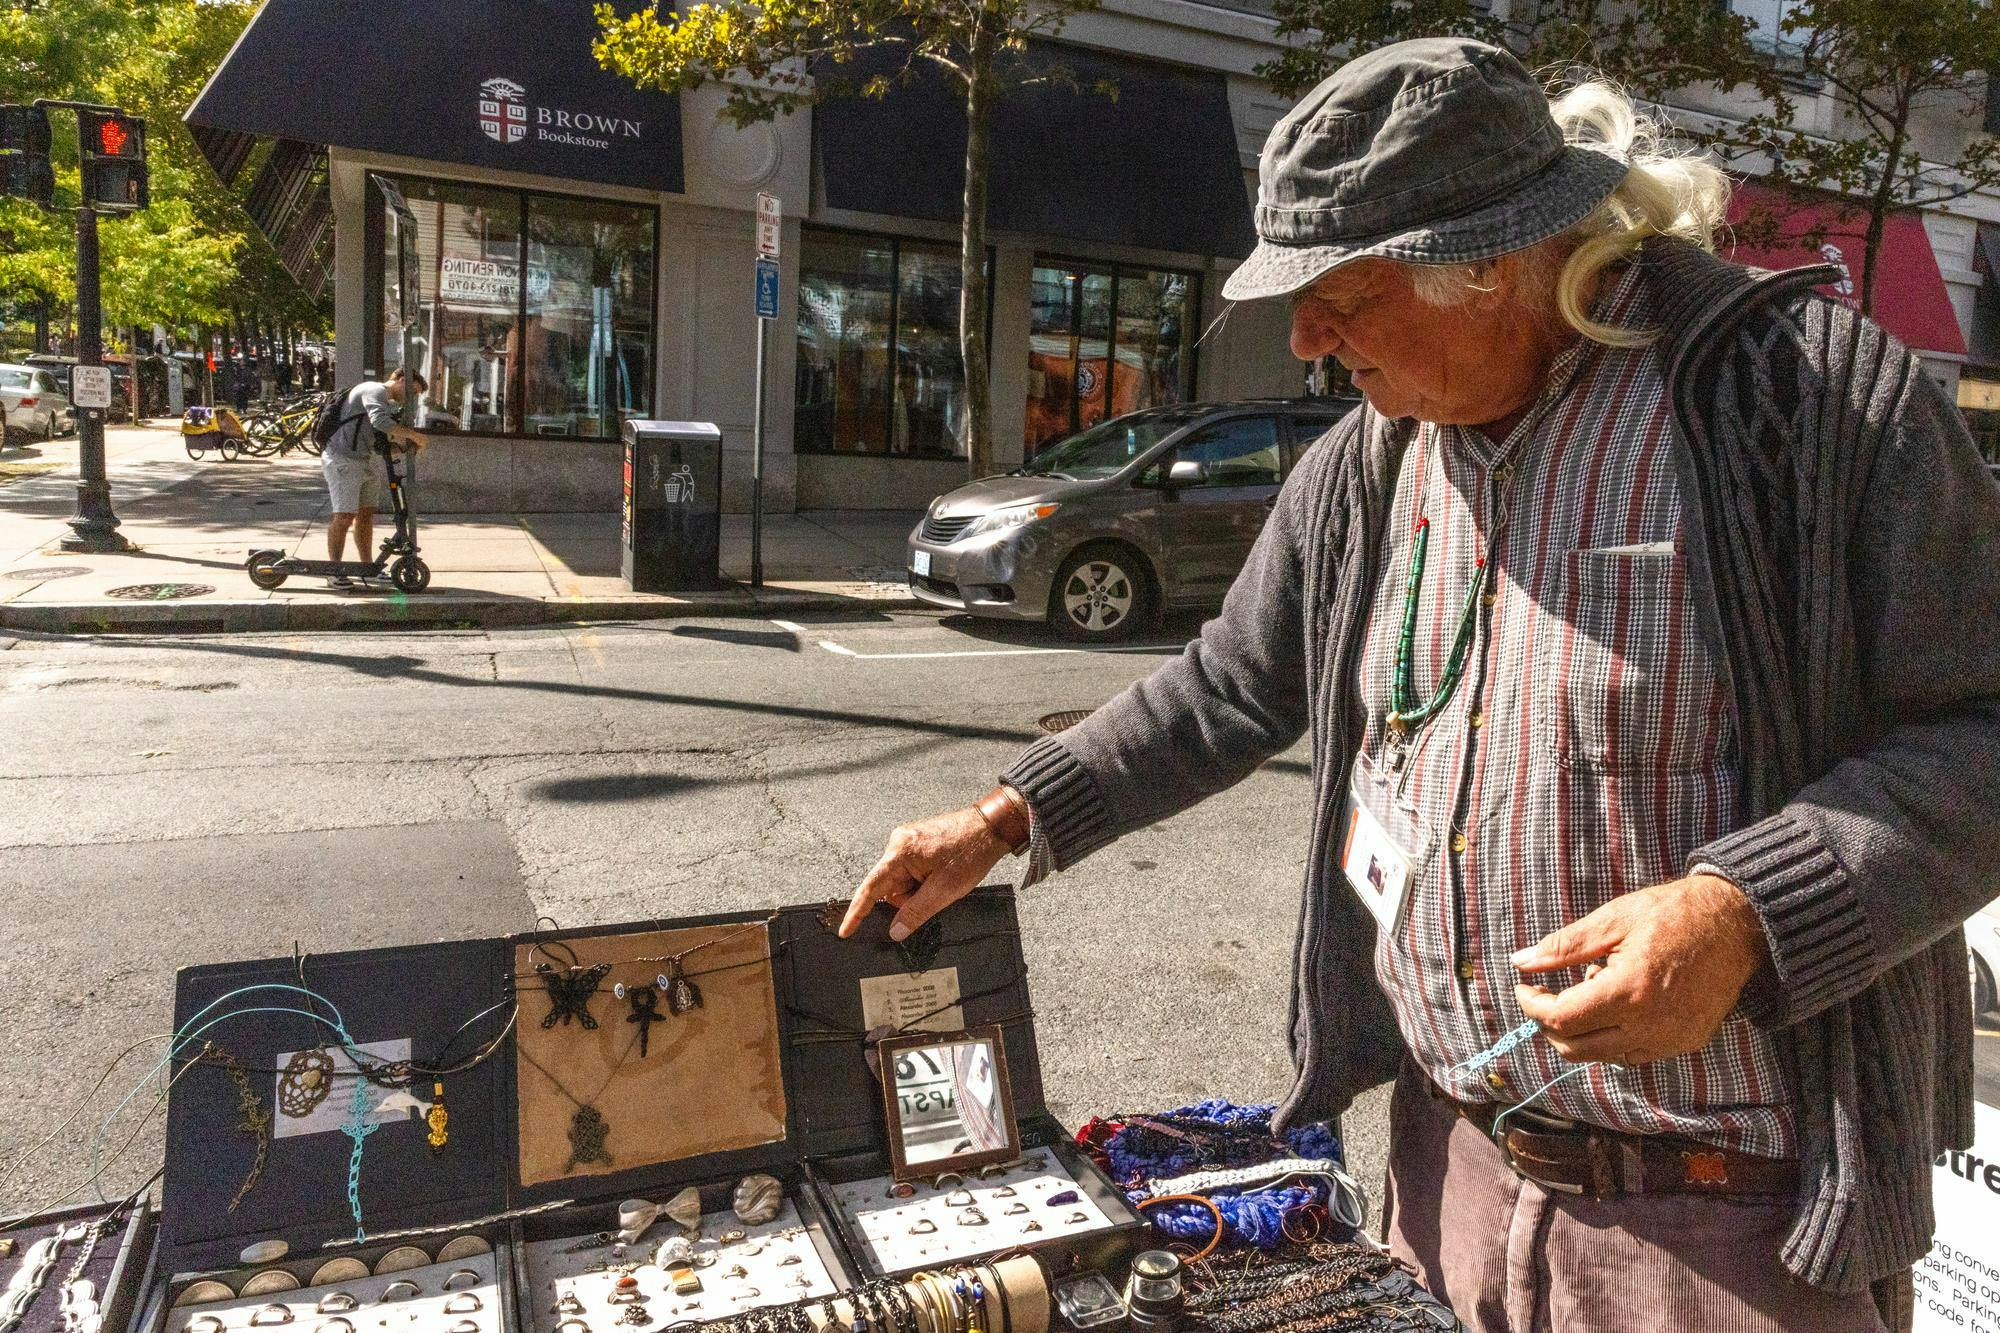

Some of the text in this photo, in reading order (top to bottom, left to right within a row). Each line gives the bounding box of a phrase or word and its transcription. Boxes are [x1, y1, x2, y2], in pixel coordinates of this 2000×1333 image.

[536, 107, 642, 138] BROWN
[538, 129, 609, 149] Bookstore
[764, 199, 774, 213] NO
[1923, 1255, 1976, 1294] parking
[1955, 1250, 2000, 1282] conve
[1928, 1299, 1965, 1326] code
